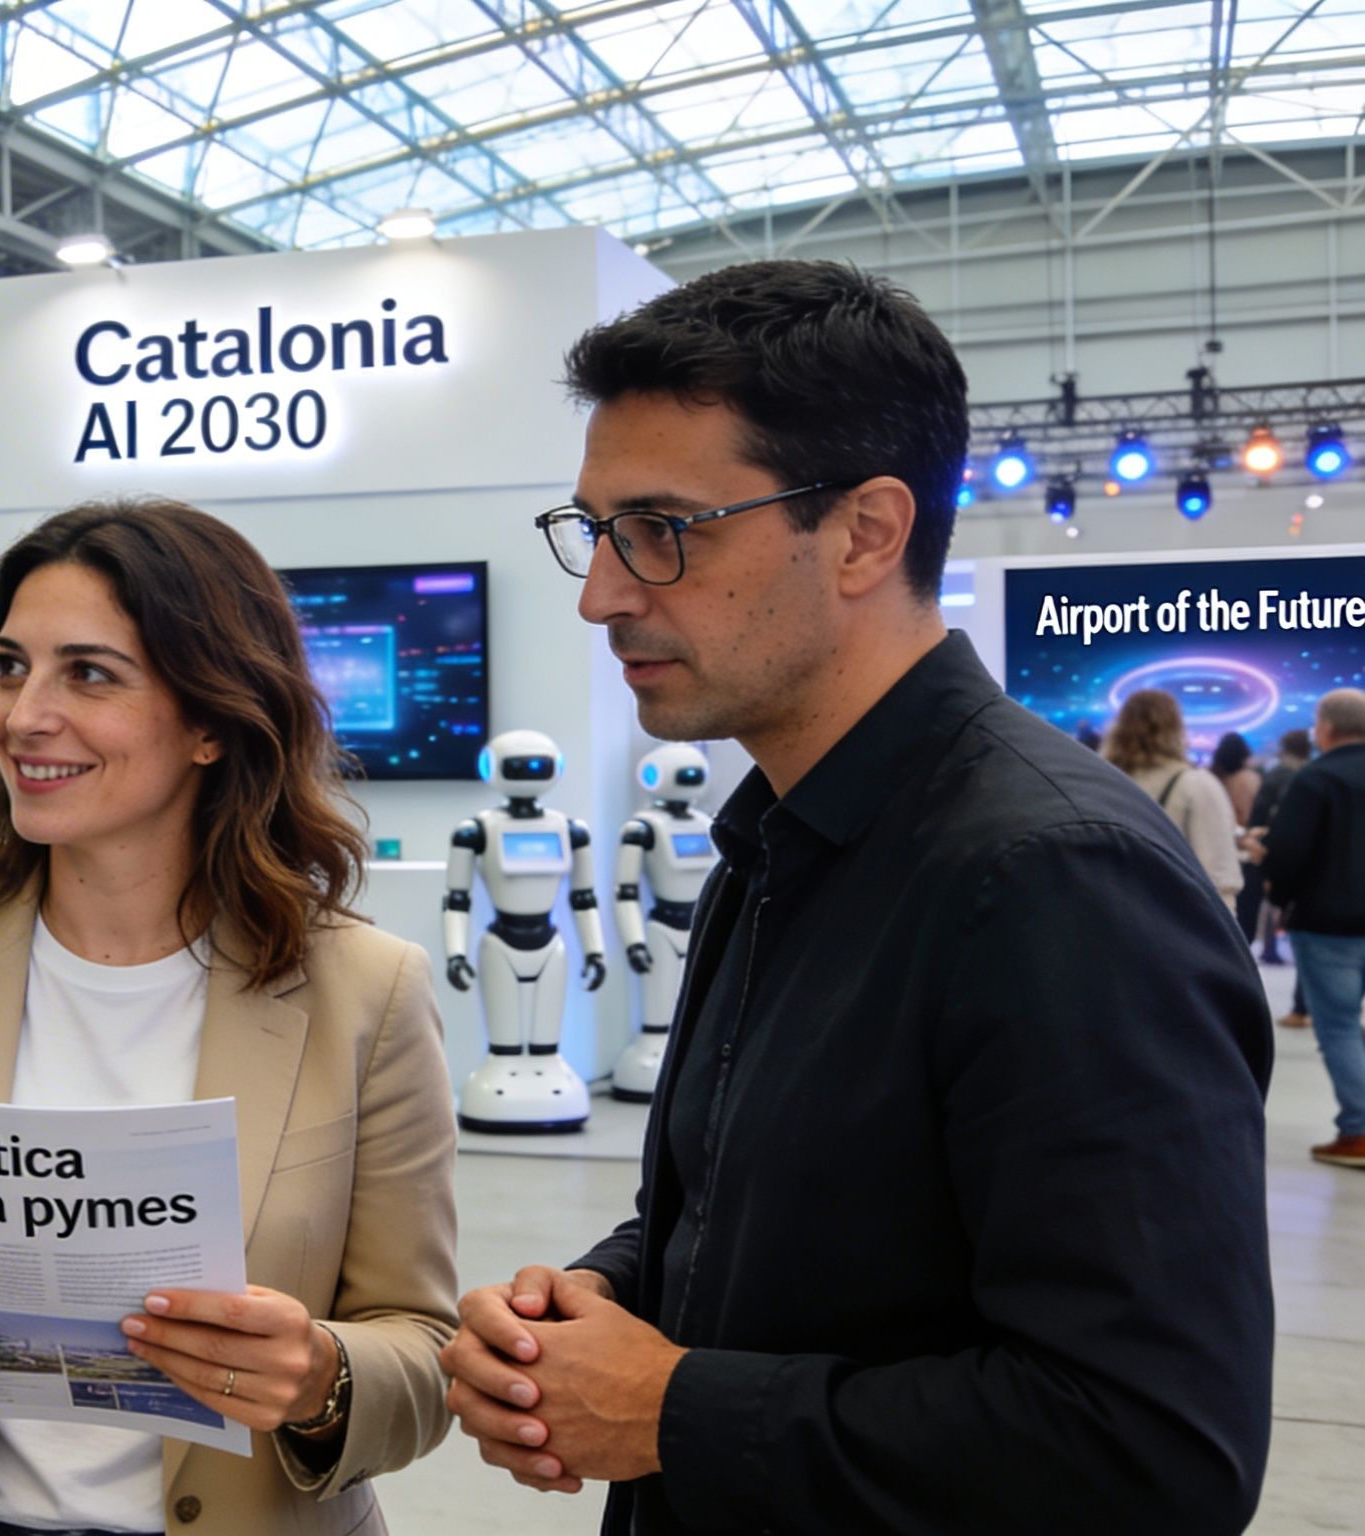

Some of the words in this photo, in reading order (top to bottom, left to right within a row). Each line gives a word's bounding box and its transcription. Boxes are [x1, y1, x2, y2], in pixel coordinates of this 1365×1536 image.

[75, 298, 449, 386] Catalonia
[74, 401, 137, 463] AI
[160, 389, 327, 456] 2030
[1036, 595, 1149, 645] Airport
[1157, 589, 1191, 632] of
[1197, 588, 1250, 632] the
[1259, 590, 1365, 630] Future
[23, 1192, 197, 1239] pymes
